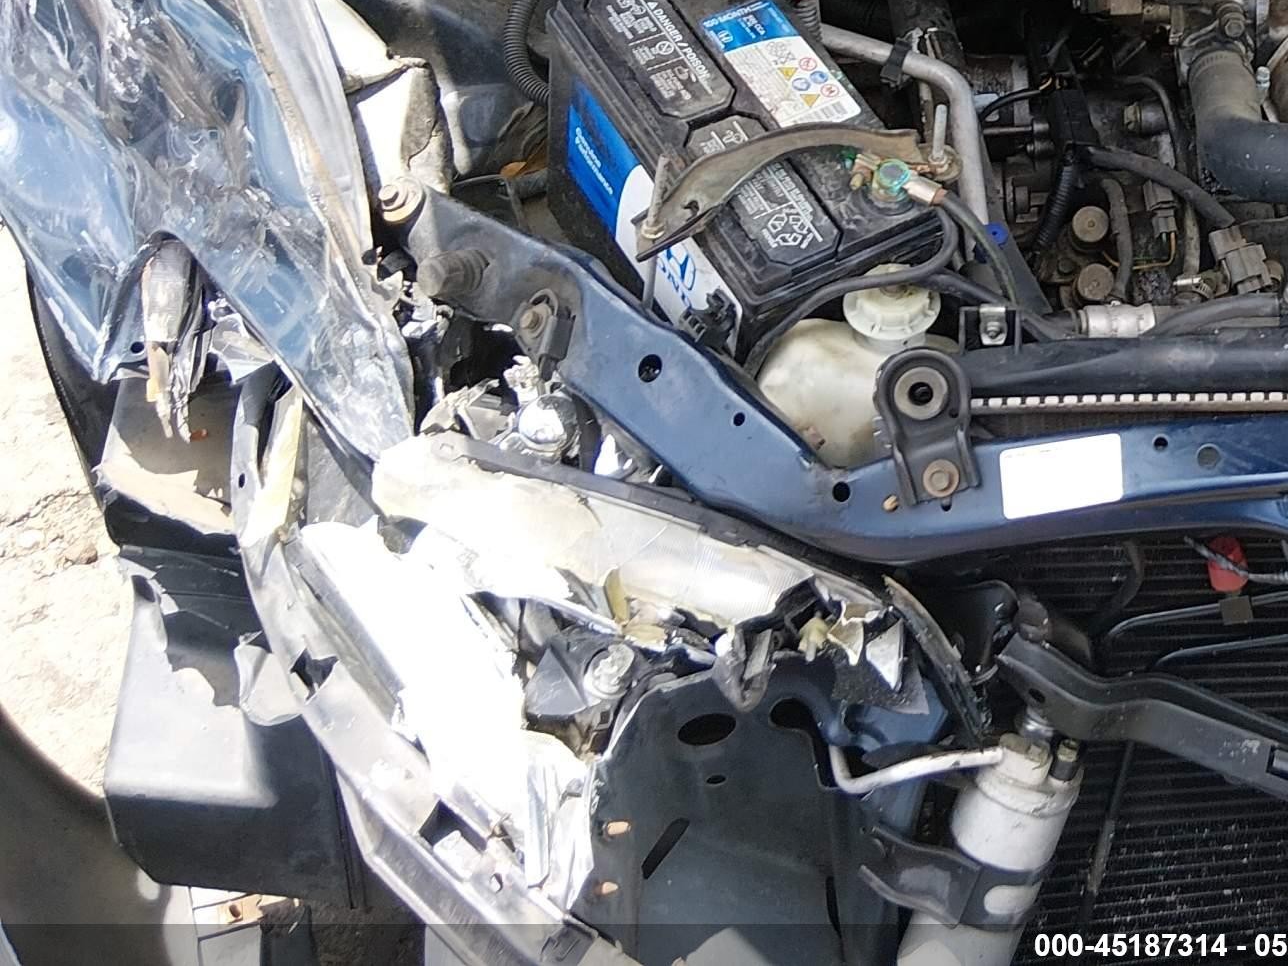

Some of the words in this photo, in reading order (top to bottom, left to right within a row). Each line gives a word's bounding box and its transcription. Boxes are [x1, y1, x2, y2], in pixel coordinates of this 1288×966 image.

[718, 6, 751, 22] MONTH
[653, 8, 683, 41] DANGER
[682, 47, 710, 77] POISON
